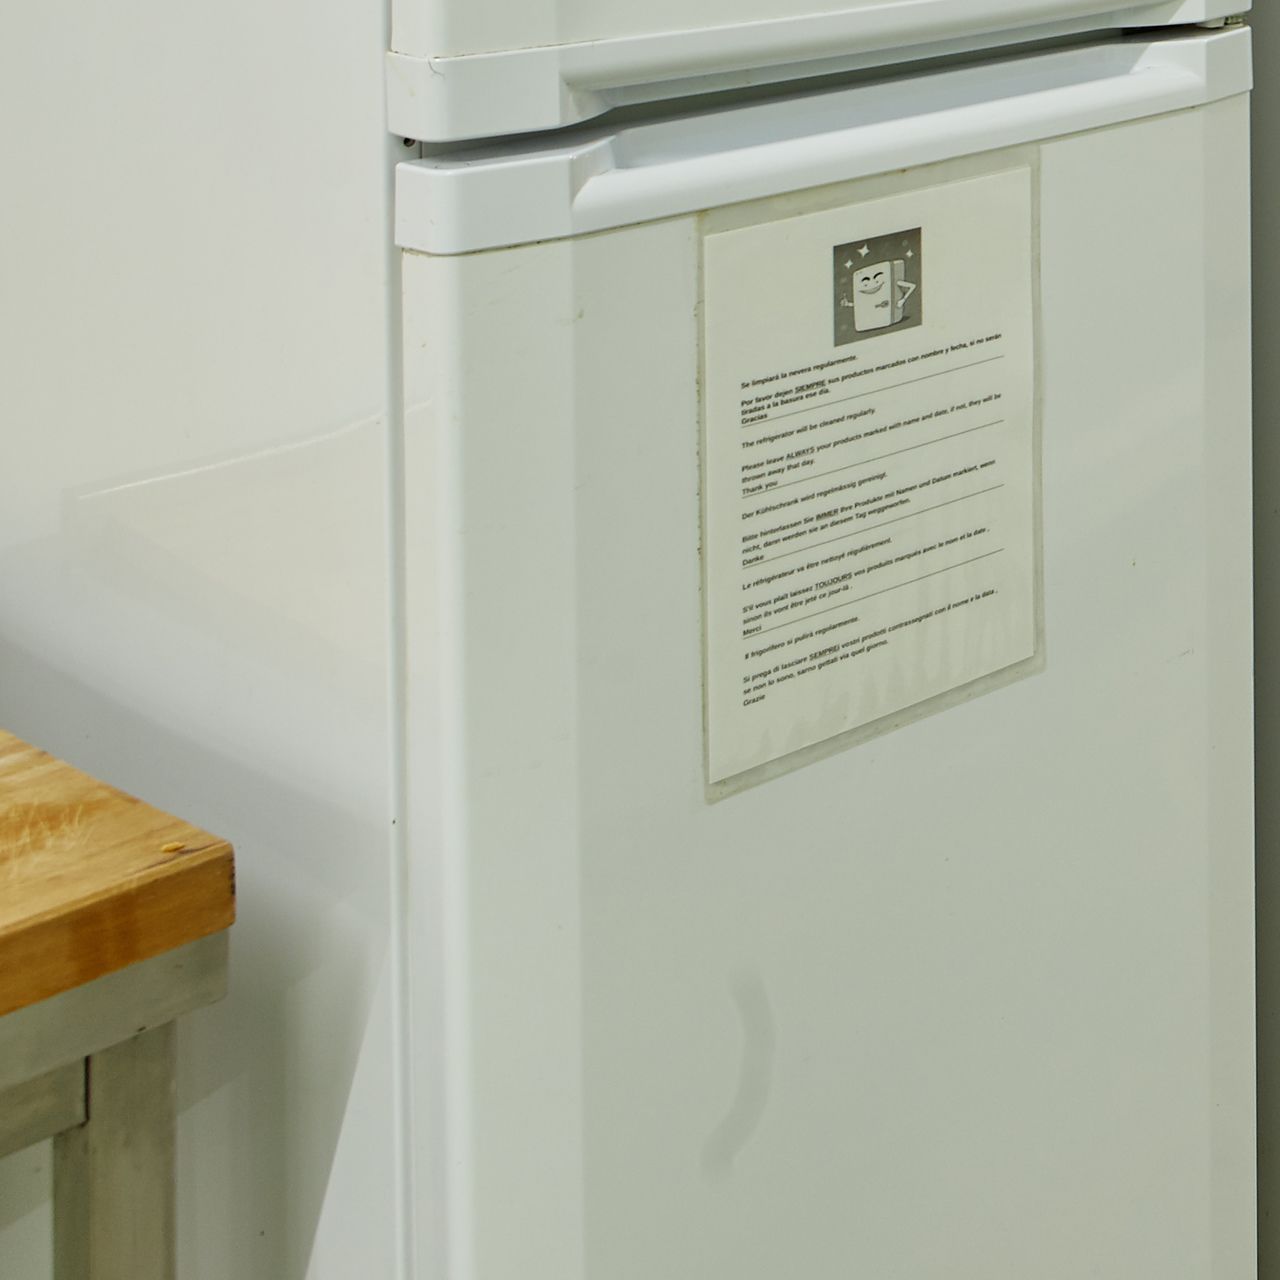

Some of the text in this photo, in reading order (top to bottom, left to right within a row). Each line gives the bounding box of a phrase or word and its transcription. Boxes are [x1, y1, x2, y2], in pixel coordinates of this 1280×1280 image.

[754, 394, 772, 403] favor
[773, 389, 793, 398] dejen
[794, 379, 826, 393] SIEMPRE
[841, 367, 873, 381] productos
[874, 359, 906, 371] marcados
[920, 349, 943, 359] nombre
[788, 366, 811, 376] nevera
[740, 404, 765, 415] tiradas
[779, 395, 803, 405] basura
[741, 413, 767, 424] Gracias
[756, 430, 794, 444] refrigerator
[818, 415, 845, 427] cleaned
[741, 461, 764, 472] Please
[766, 455, 784, 464] leave
[785, 446, 814, 459] ALWAYS
[816, 442, 831, 452] your
[832, 434, 861, 447] products
[863, 425, 887, 437] marked
[902, 417, 920, 426] name
[741, 472, 765, 483] thrown
[767, 467, 785, 476] away
[742, 483, 763, 494] Thank
[800, 492, 815, 501] wird
[742, 533, 758, 542] Bitte
[759, 520, 801, 537] hinterlassen
[815, 508, 838, 520] IMMER
[854, 495, 883, 508] Produkte
[895, 484, 917, 495] Namen
[931, 473, 951, 483] Datum
[979, 459, 995, 468] wenn
[763, 538, 780, 547] dann
[781, 530, 807, 541] werden
[829, 515, 853, 527] diesem
[742, 554, 764, 565] Danke
[754, 599, 771, 608] vous
[789, 585, 812, 597] laissez
[814, 571, 852, 589] TOUJOURS
[866, 559, 893, 573] produits
[742, 613, 762, 624] sinon
[773, 604, 788, 614] vont
[742, 624, 761, 635] Merci
[751, 669, 771, 681] prega
[780, 656, 807, 670] lasciare
[952, 598, 968, 608] nome
[850, 645, 865, 656] quel
[743, 694, 765, 706] Grazie
